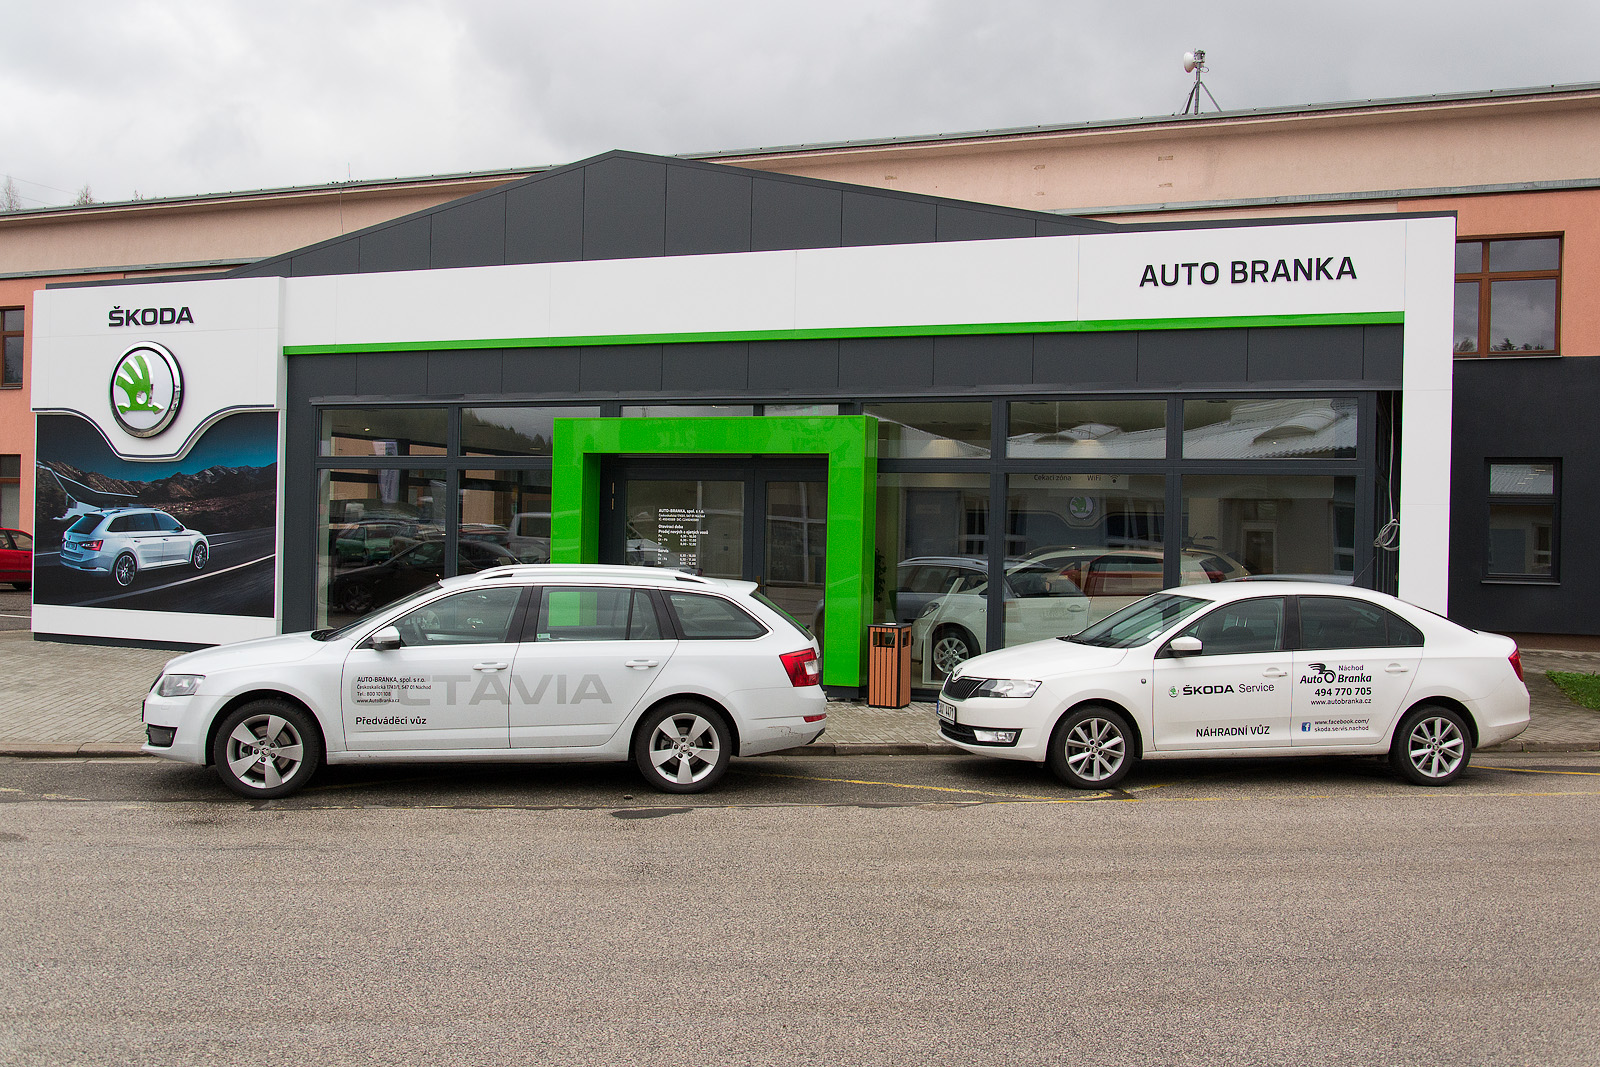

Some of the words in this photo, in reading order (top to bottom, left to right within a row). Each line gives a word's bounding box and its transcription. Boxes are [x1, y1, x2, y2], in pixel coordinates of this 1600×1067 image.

[1139, 261, 1220, 287] AUTO
[1230, 256, 1358, 284] BRANKA
[108, 305, 194, 327] ŠKODA
[1299, 674, 1323, 684] Auto
[1337, 672, 1372, 683] Branka
[351, 674, 613, 707] OCTAVIA
[1182, 684, 1235, 696] ŠKODA
[1238, 682, 1275, 693] Service
[1314, 688, 1333, 696] 494
[1334, 687, 1353, 696] 770
[1354, 686, 1372, 696] 705
[355, 716, 408, 725] Předváděcí
[409, 715, 427, 725] vůz
[1195, 725, 1248, 738] NÁHRADNÍ
[1250, 723, 1271, 735] VŮZ
